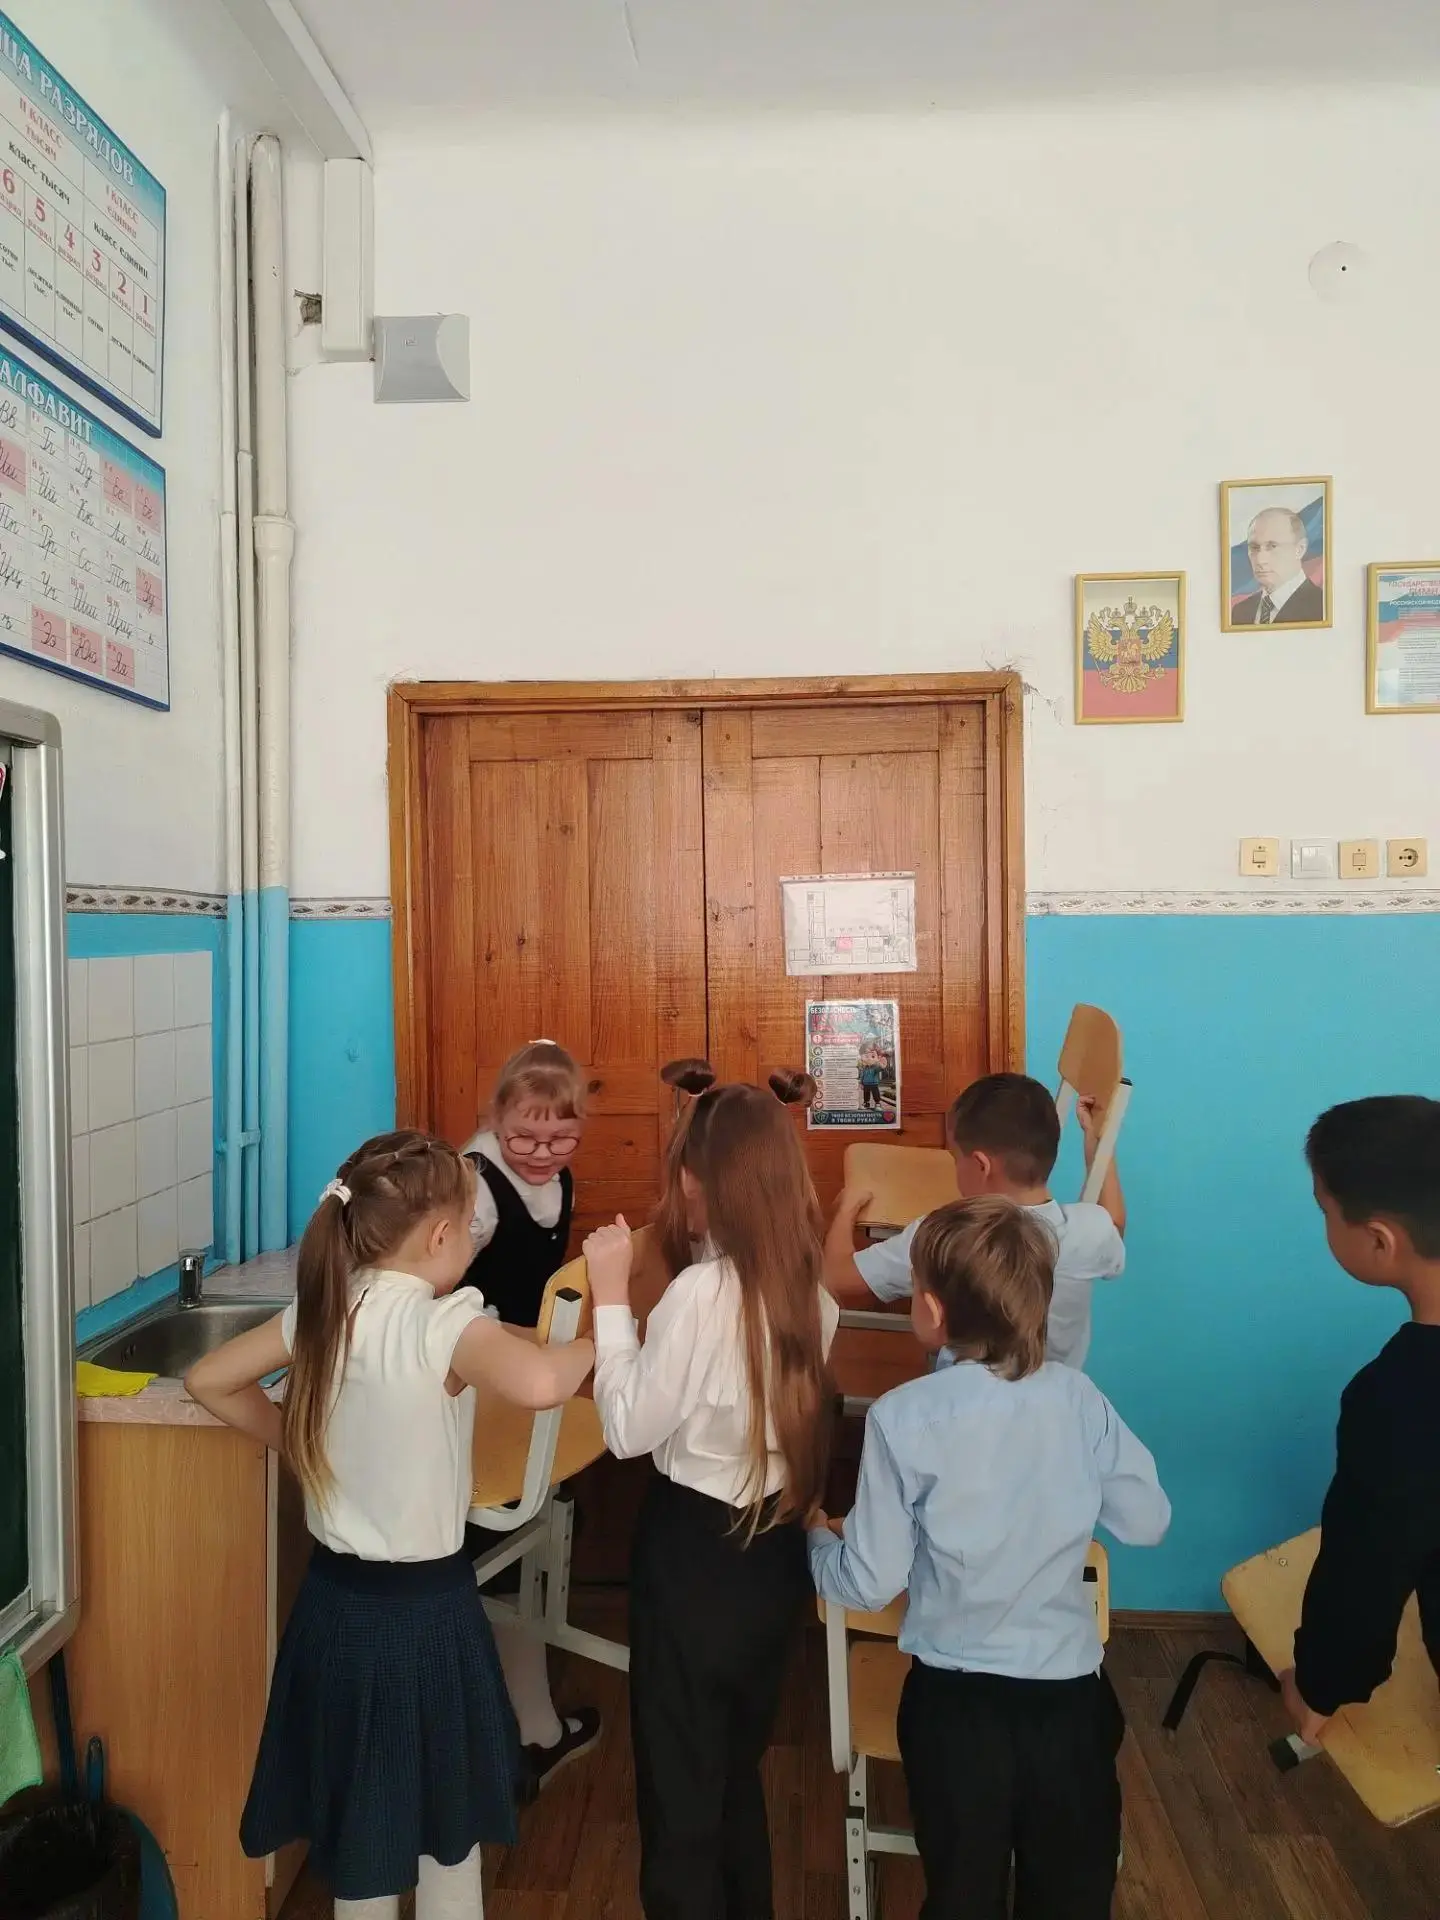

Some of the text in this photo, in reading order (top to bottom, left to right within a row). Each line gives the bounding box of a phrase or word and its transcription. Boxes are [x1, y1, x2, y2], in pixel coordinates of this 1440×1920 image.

[29, 107, 63, 149] КЛАСС
[40, 69, 134, 187] РАЗРЯДОВ
[3, 168, 15, 194] 6
[9, 141, 70, 205] класс тысяч
[34, 197, 46, 222] 5
[111, 190, 139, 224] КЛАСС
[64, 223, 75, 249] 4
[93, 221, 118, 250] класс
[91, 248, 102, 272] 3
[117, 271, 127, 294] 2
[143, 294, 148, 315] 1
[0, 358, 93, 444] АЛФАВИТ
